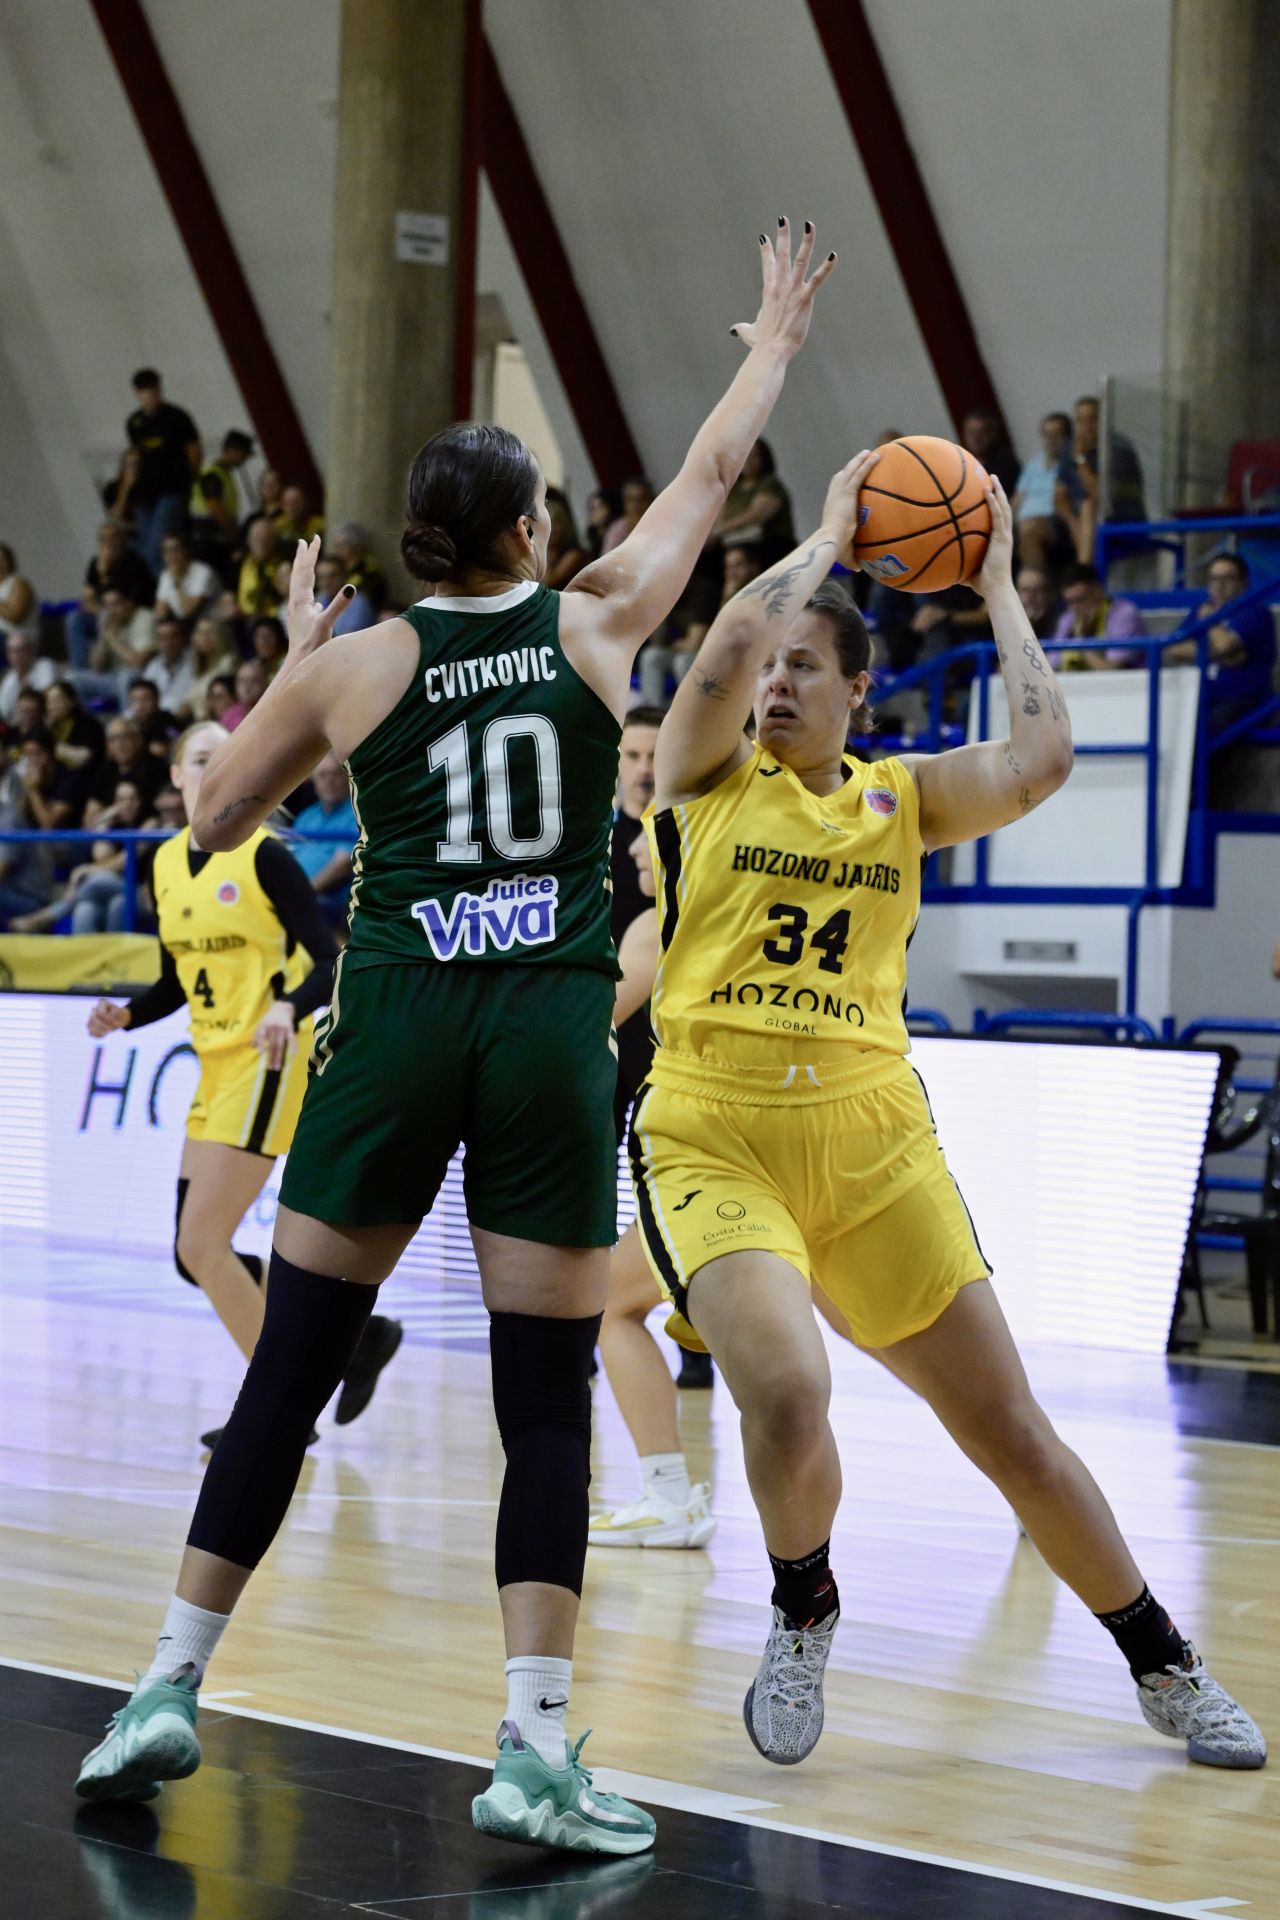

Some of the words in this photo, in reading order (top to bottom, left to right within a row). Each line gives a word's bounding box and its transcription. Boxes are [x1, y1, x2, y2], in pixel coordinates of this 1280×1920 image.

[425, 646, 557, 702] CVITKOVIC
[427, 714, 563, 863] 10
[486, 878, 553, 903] Juice
[732, 845, 830, 883] HOZONO
[833, 863, 900, 894] JAIRIS
[416, 898, 553, 957] Viva
[763, 902, 851, 974] 34
[194, 967, 215, 1009] 4
[710, 982, 865, 1027] HOZONO
[765, 1017, 817, 1035] GLOBAL
[703, 1227, 735, 1241] Costa
